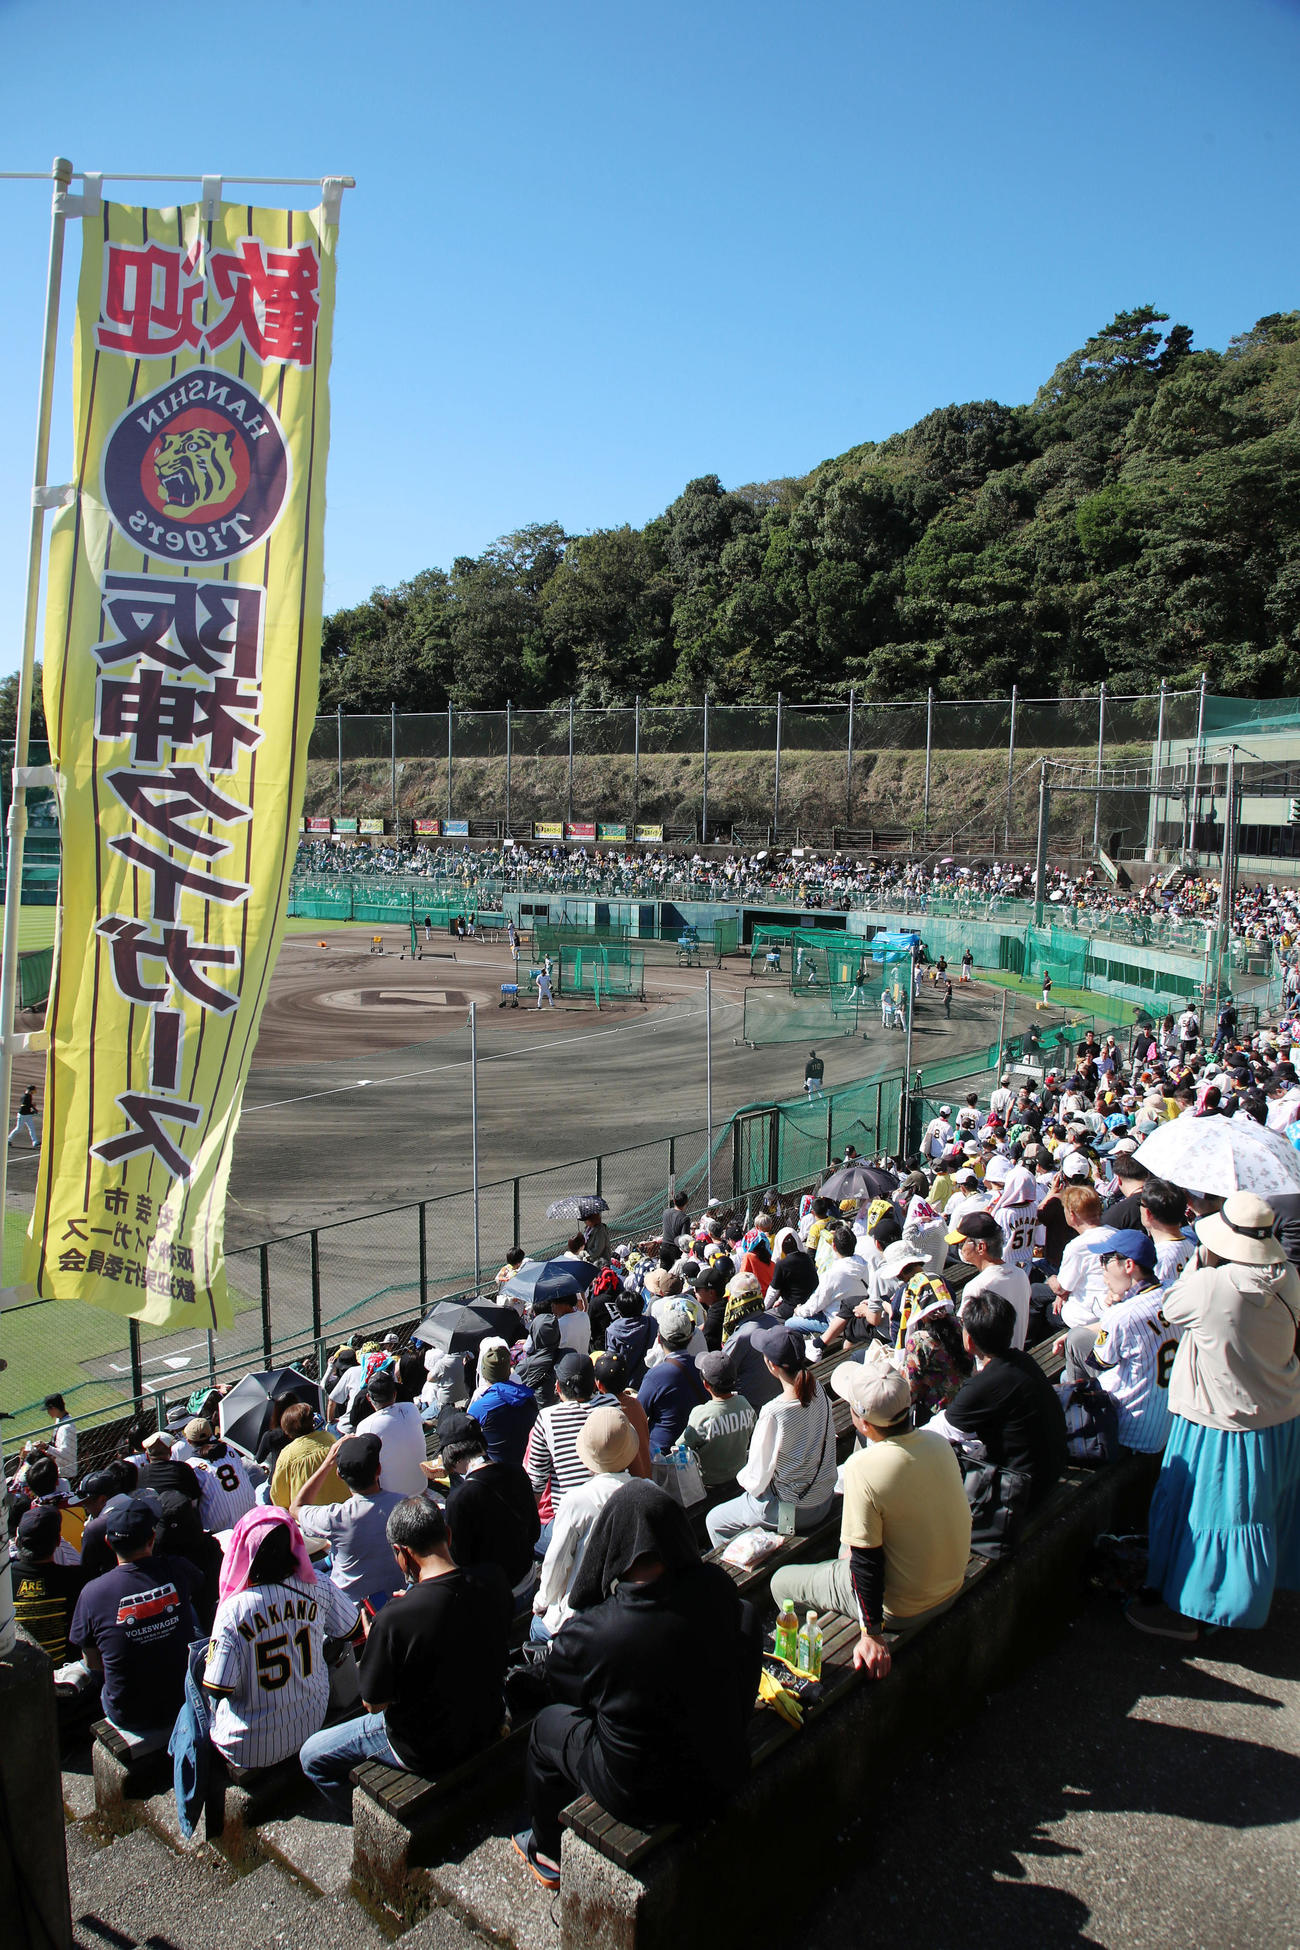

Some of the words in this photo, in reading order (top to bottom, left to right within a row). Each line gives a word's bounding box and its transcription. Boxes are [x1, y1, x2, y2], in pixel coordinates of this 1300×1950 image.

[1012, 1228, 1034, 1250] 51
[216, 1463, 240, 1492] 8
[18, 1579, 44, 1595] ARE
[125, 1615, 179, 1638] VOLKSWAGEN
[237, 1599, 317, 1642] NAKANO
[255, 1624, 313, 1692] 51
